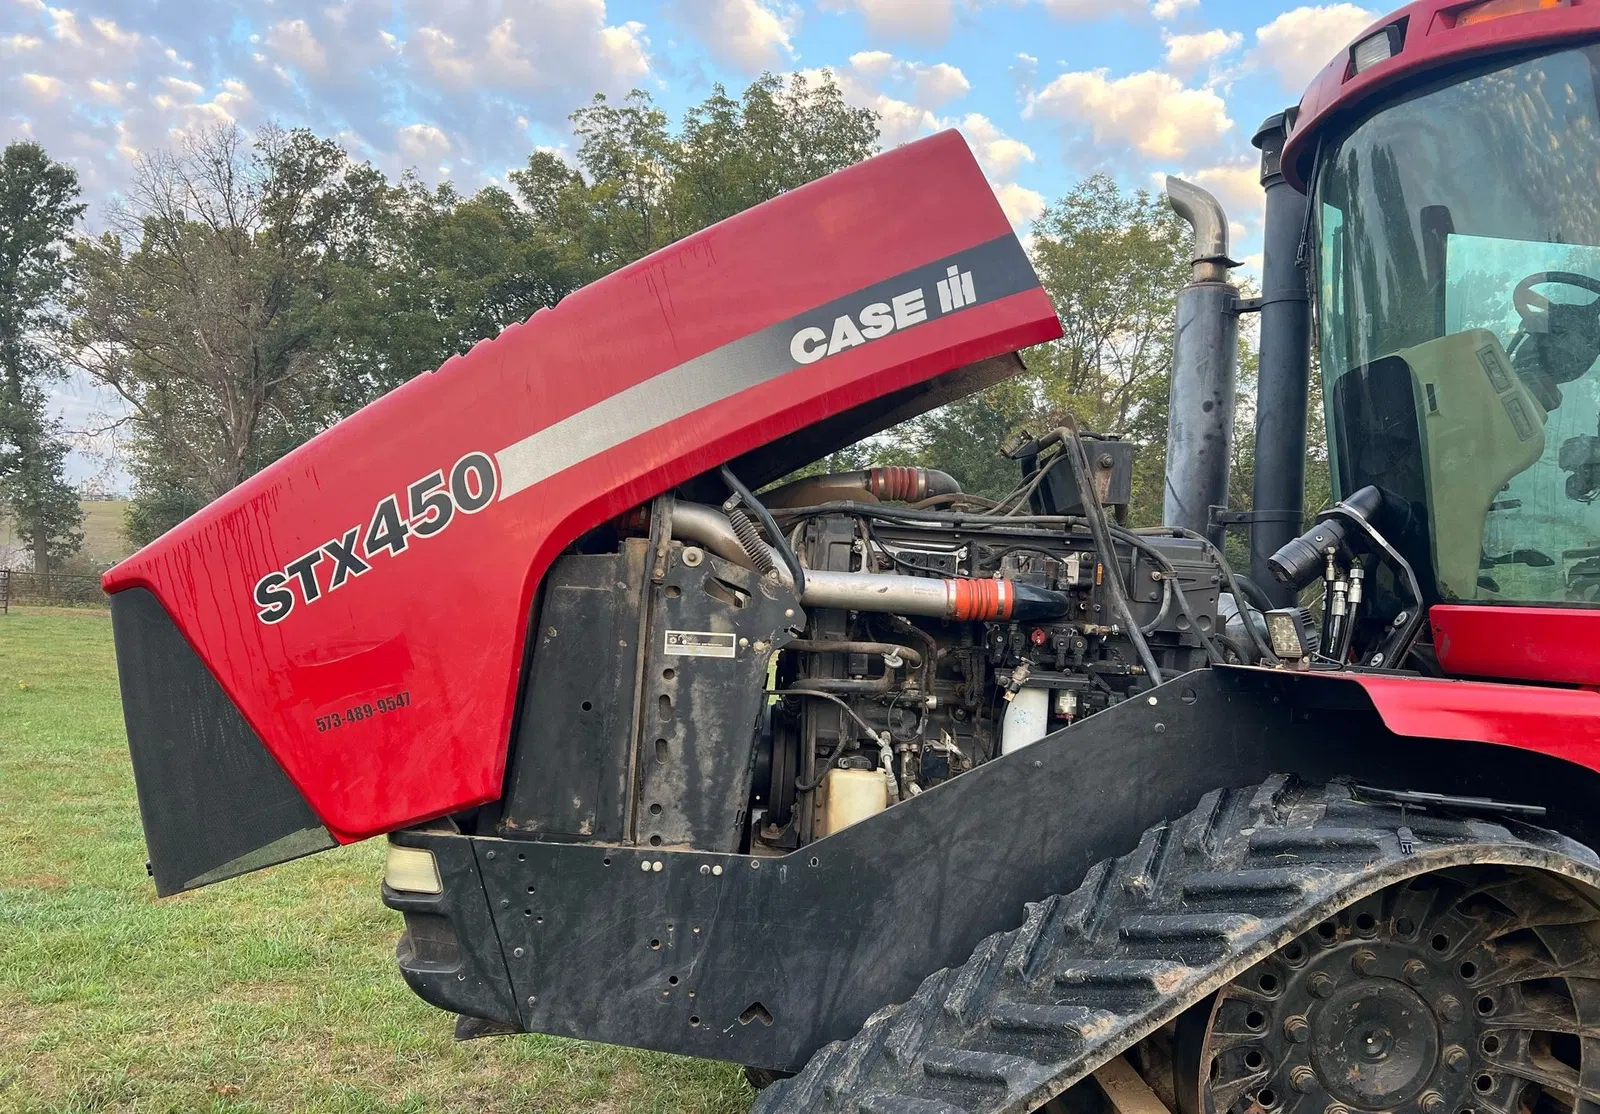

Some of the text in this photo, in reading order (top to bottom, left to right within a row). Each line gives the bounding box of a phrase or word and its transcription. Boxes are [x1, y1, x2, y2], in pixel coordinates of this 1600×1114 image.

[790, 288, 927, 364] CASE
[254, 451, 497, 625] STX450
[315, 691, 411, 732] 573-489-9547
